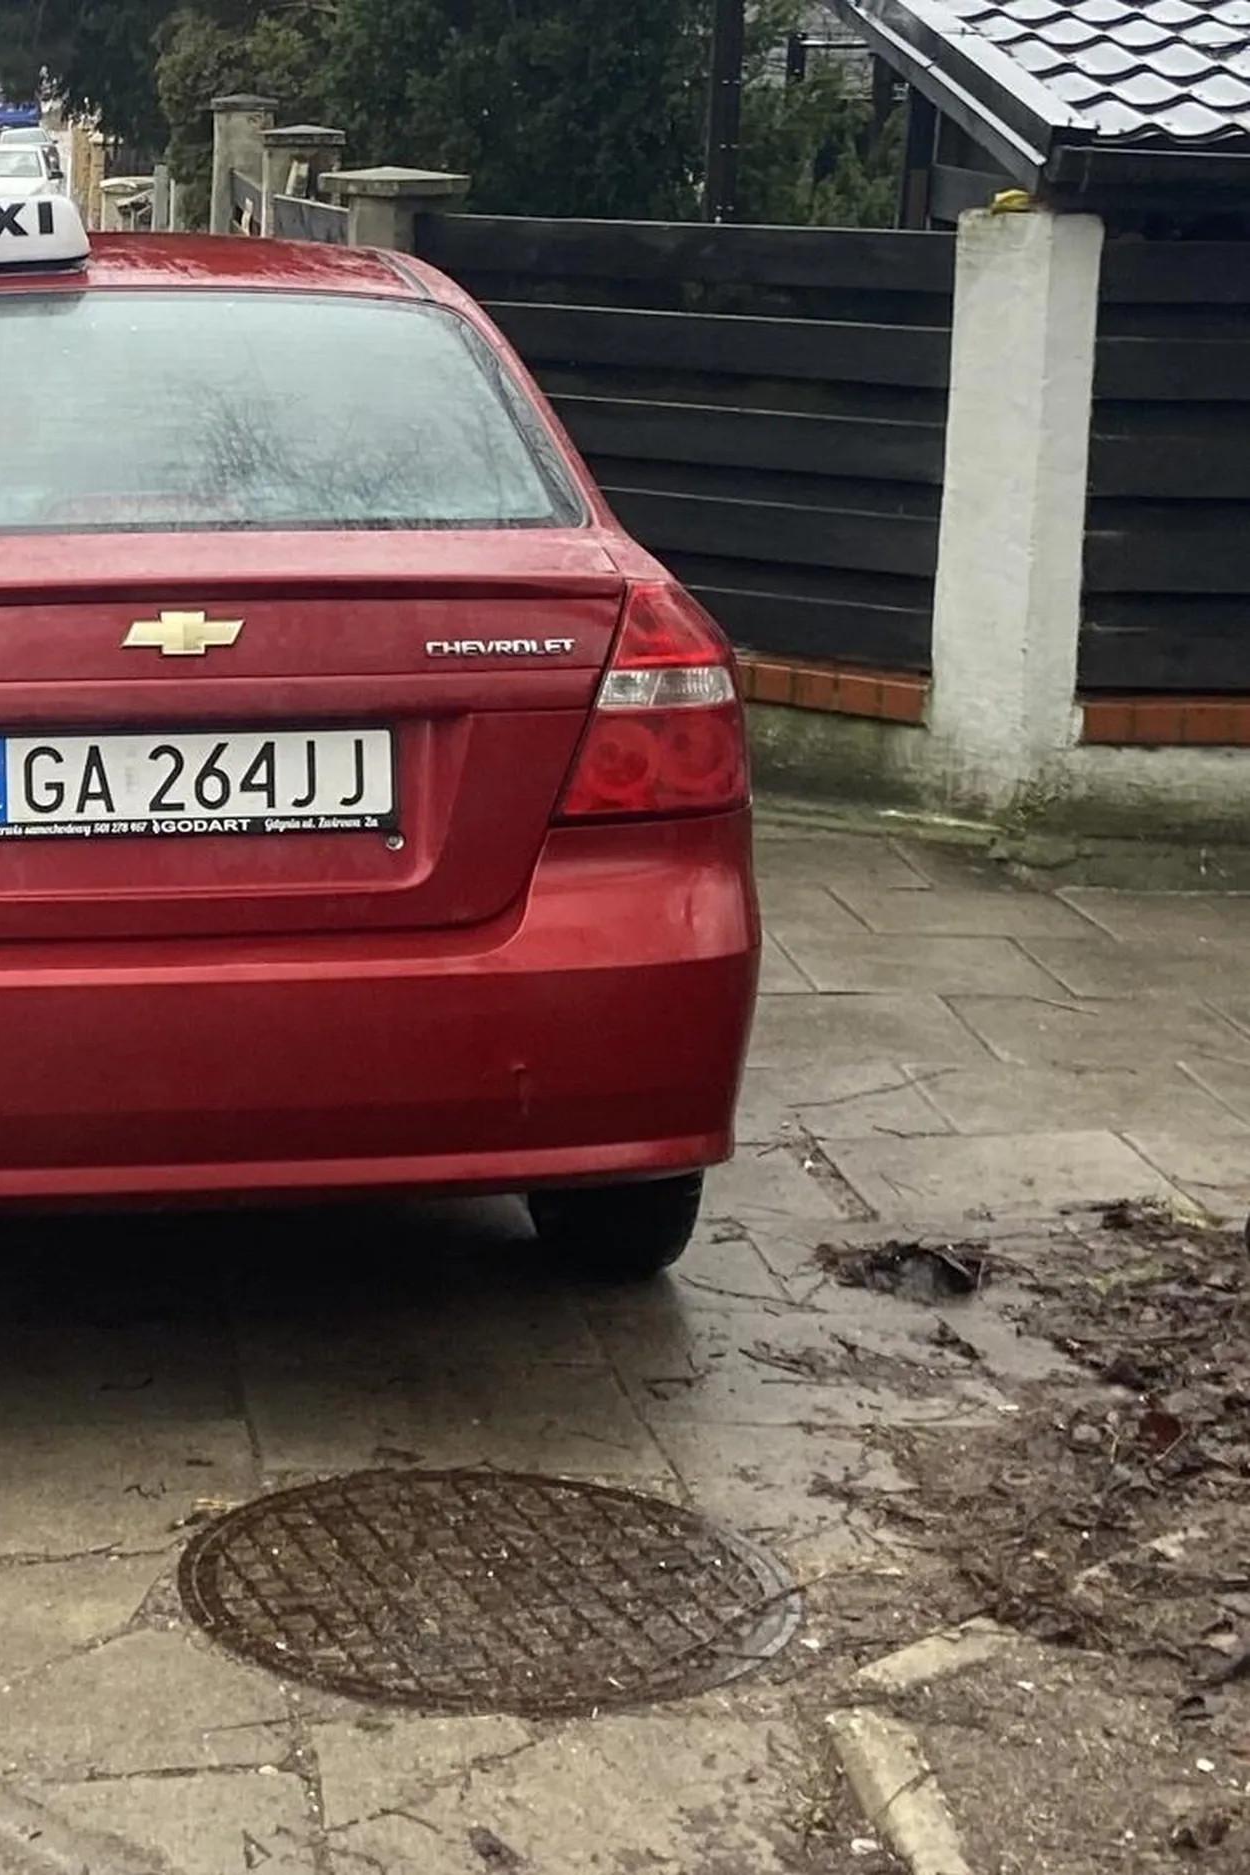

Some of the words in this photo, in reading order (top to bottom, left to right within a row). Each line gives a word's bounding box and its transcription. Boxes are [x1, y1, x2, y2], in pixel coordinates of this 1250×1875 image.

[426, 638, 575, 656] CHEVROLET
[23, 745, 115, 814] GA
[148, 739, 364, 812] 264JJ
[160, 819, 251, 833] GODART
